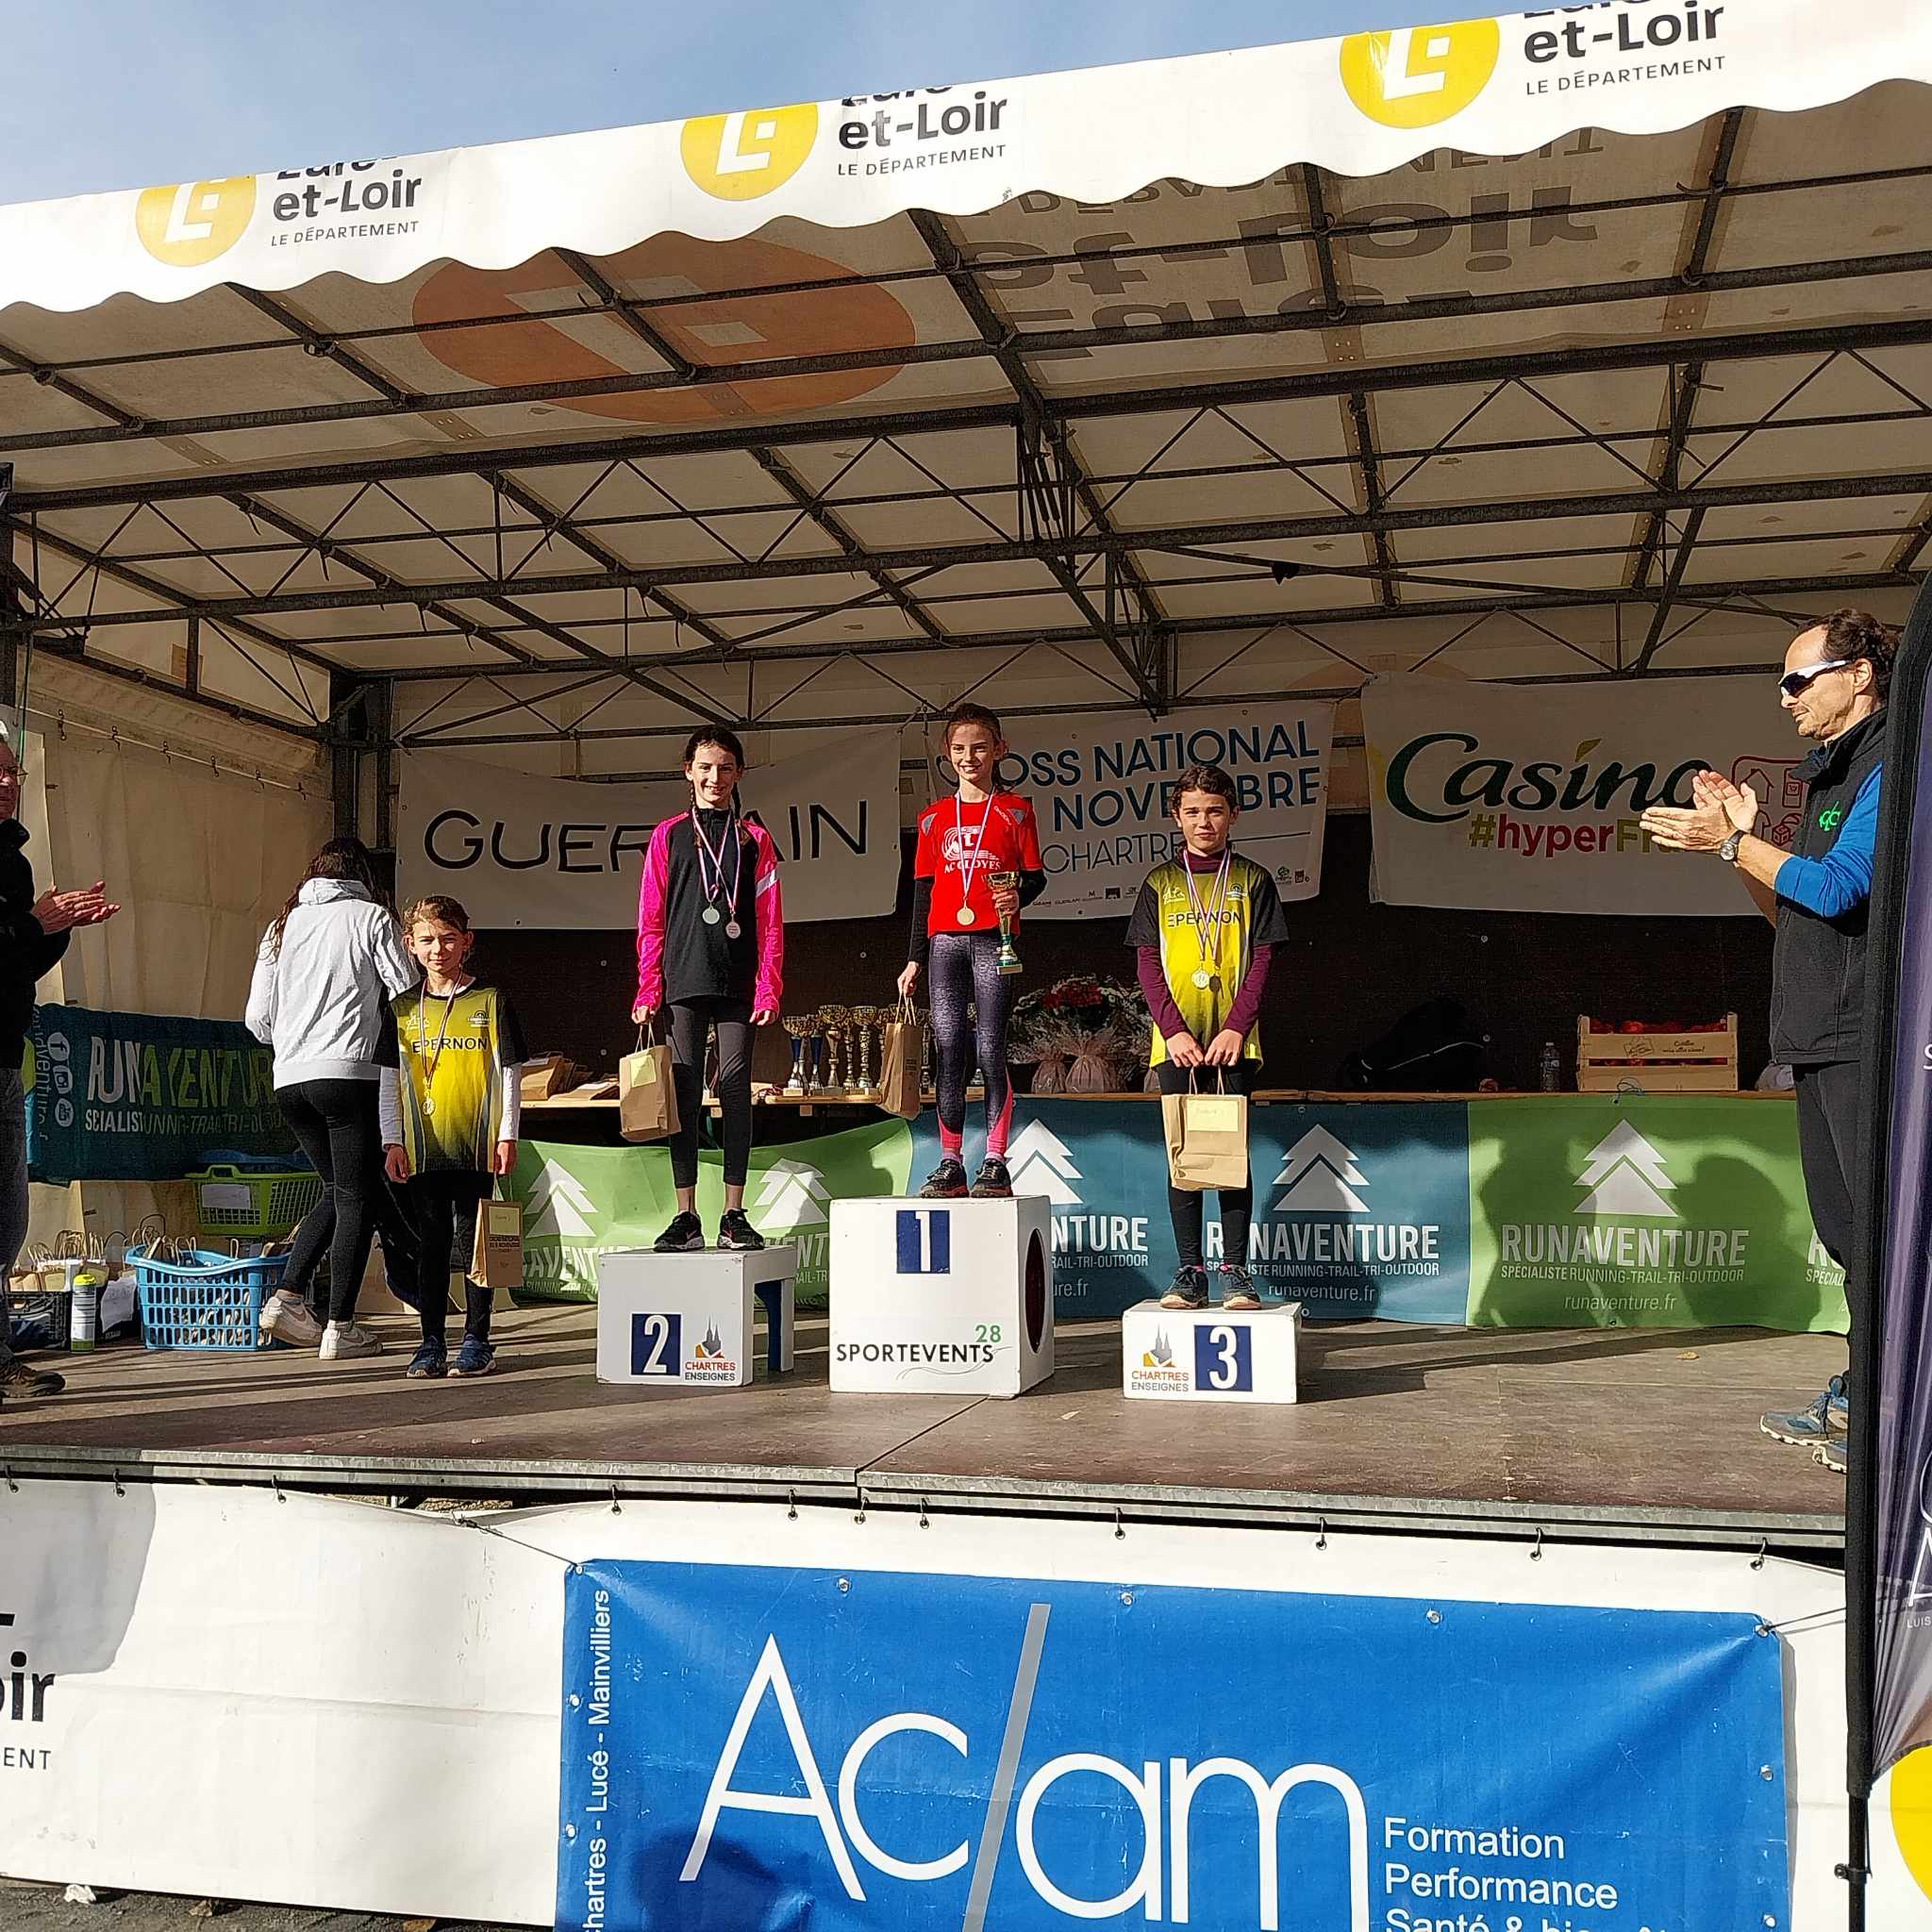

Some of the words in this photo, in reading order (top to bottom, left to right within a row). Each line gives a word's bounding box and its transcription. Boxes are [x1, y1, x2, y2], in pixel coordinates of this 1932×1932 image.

[1524, 0, 1724, 63] et-Loir
[1526, 80, 1548, 95] LE
[1558, 56, 1725, 91] DÉPARTEMENT
[838, 91, 1008, 150] et-Loir
[838, 163, 858, 175] LE
[865, 144, 1007, 175] DÉPARTEMENT
[273, 169, 422, 222] et-Loir
[271, 234, 288, 247] LE
[294, 221, 419, 242] DÉPARTEMENT
[1093, 720, 1320, 782] NATIONAL
[1385, 731, 1713, 824] Casino
[1054, 767, 1321, 832] NOVEBRE
[411, 1037, 488, 1054] EPERNON
[914, 1210, 931, 1272] 1
[1207, 1221, 1441, 1262] RNAVENTURE
[1501, 1224, 1750, 1268] RUNAVENTURE
[1501, 1263, 1567, 1280] SPÉCIALISTE
[1268, 1283, 1375, 1303] runaventure.fr
[1564, 1292, 1678, 1311] runaventure.fr
[642, 1314, 670, 1374] 2
[836, 1343, 994, 1363] SPORTEVENTS
[974, 1324, 1002, 1343] 28
[685, 1361, 736, 1372] CHARTRES
[685, 1372, 736, 1382] ENSEIGNES
[1131, 1371, 1189, 1381] CHARTRES
[1208, 1325, 1238, 1390] 3
[1131, 1381, 1189, 1392] ENSEIGNES
[588, 1589, 611, 1725] Mainvilliers
[586, 1750, 608, 1813] Lucé
[1384, 1816, 1566, 1859] Formation
[1384, 1862, 1619, 1910] Performance
